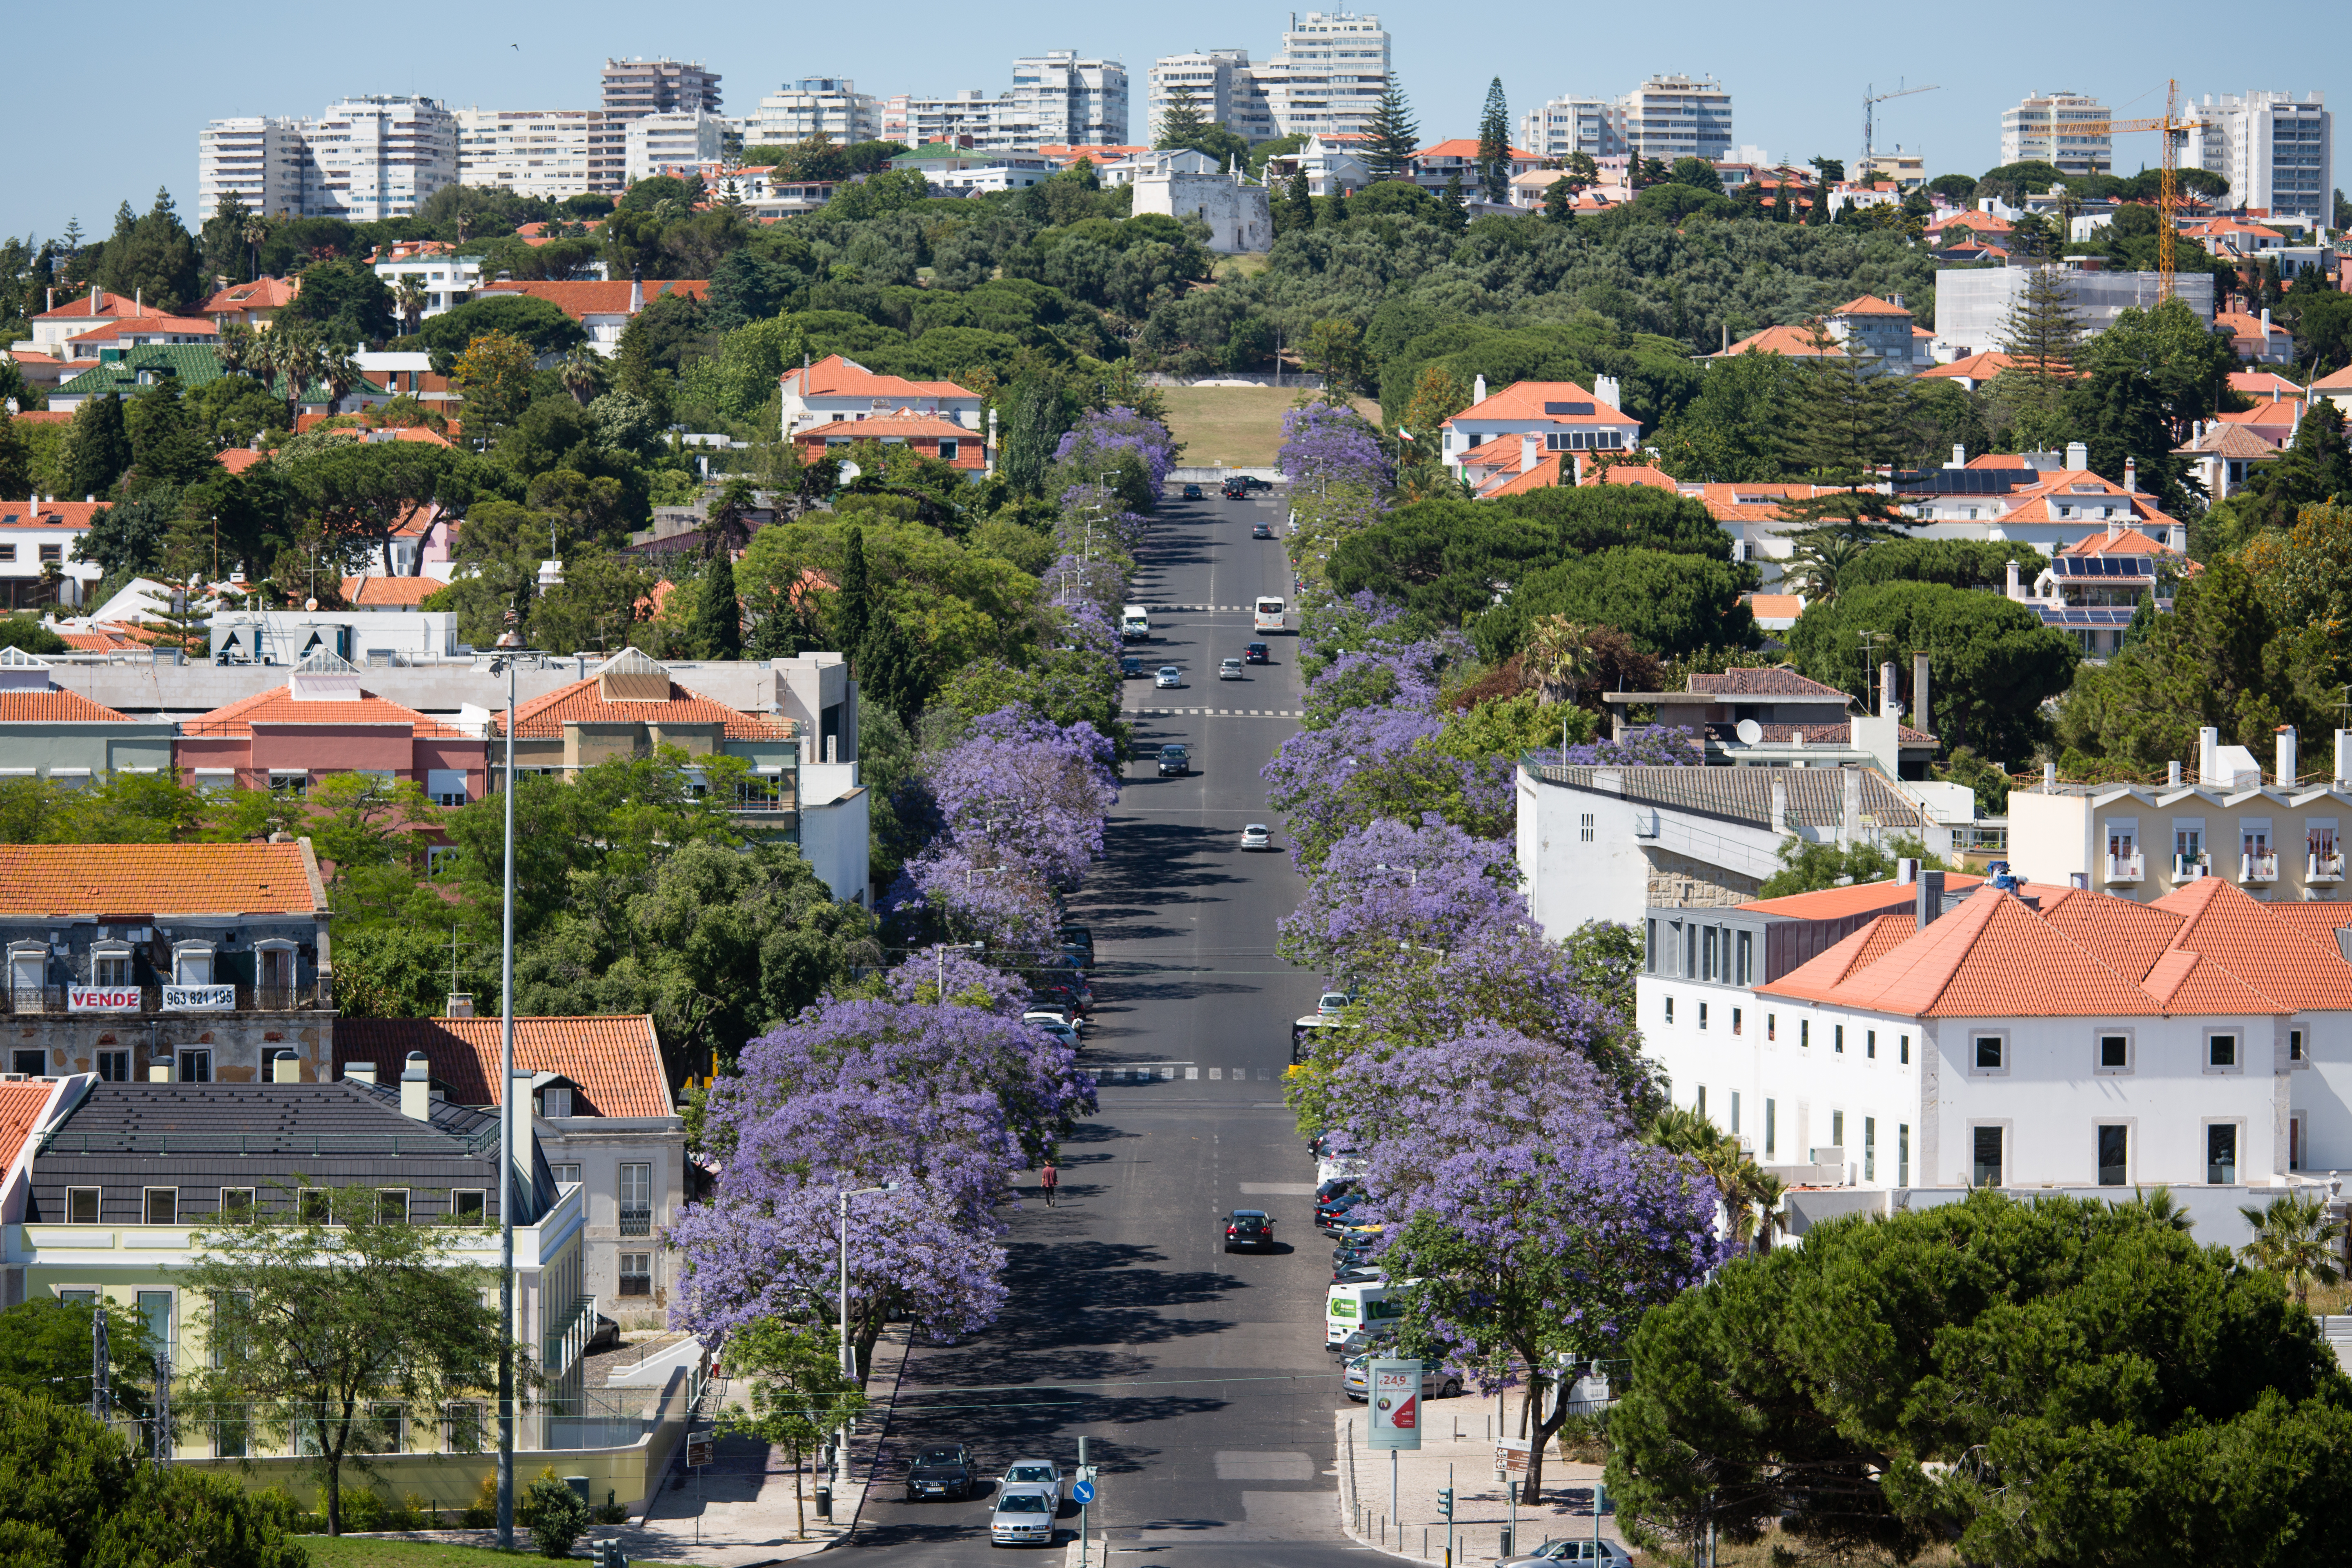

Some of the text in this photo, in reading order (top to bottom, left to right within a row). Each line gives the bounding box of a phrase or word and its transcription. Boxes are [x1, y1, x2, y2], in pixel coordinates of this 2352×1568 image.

[72, 993, 138, 1006] VENDE
[167, 990, 232, 1005] 963 821 195
